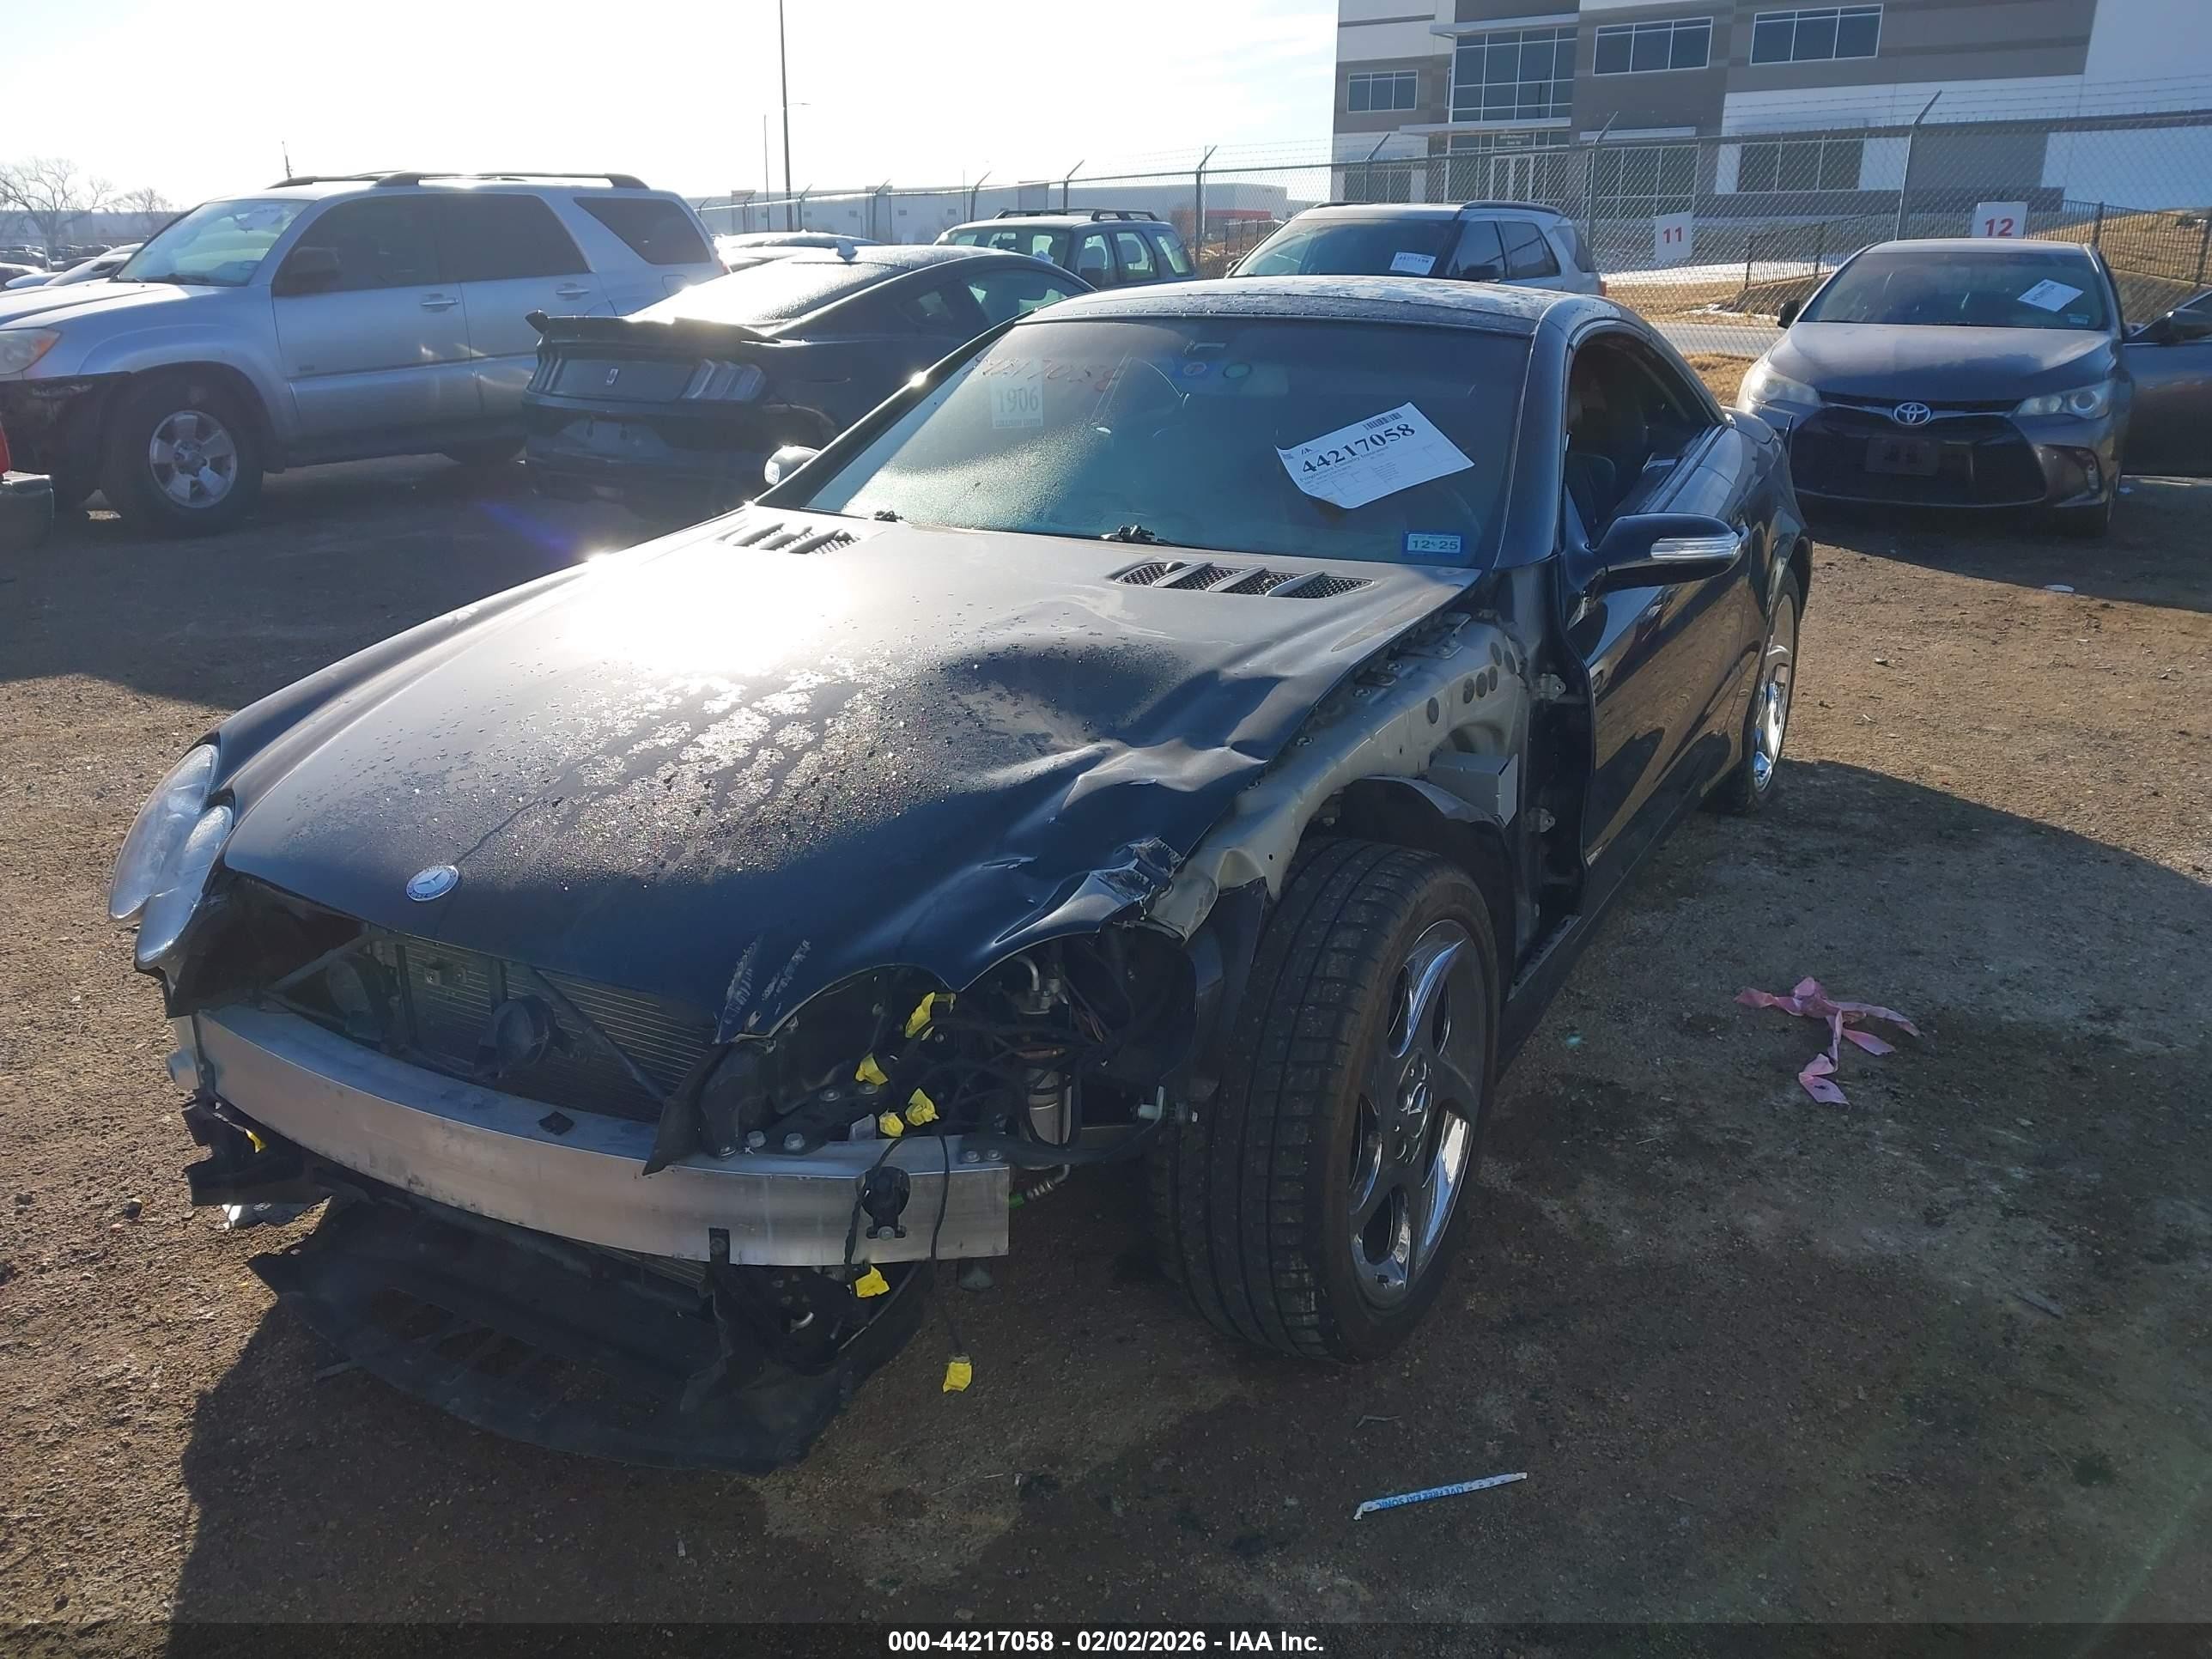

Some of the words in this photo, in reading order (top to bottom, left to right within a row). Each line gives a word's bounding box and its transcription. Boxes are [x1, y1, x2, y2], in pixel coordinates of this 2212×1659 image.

[1663, 227, 1682, 244] 11
[1985, 218, 2014, 237] 12
[1000, 386, 1039, 412] 1906
[1303, 423, 1415, 472] 44217058
[1413, 540, 1430, 549] 12
[1439, 541, 1458, 550] 25
